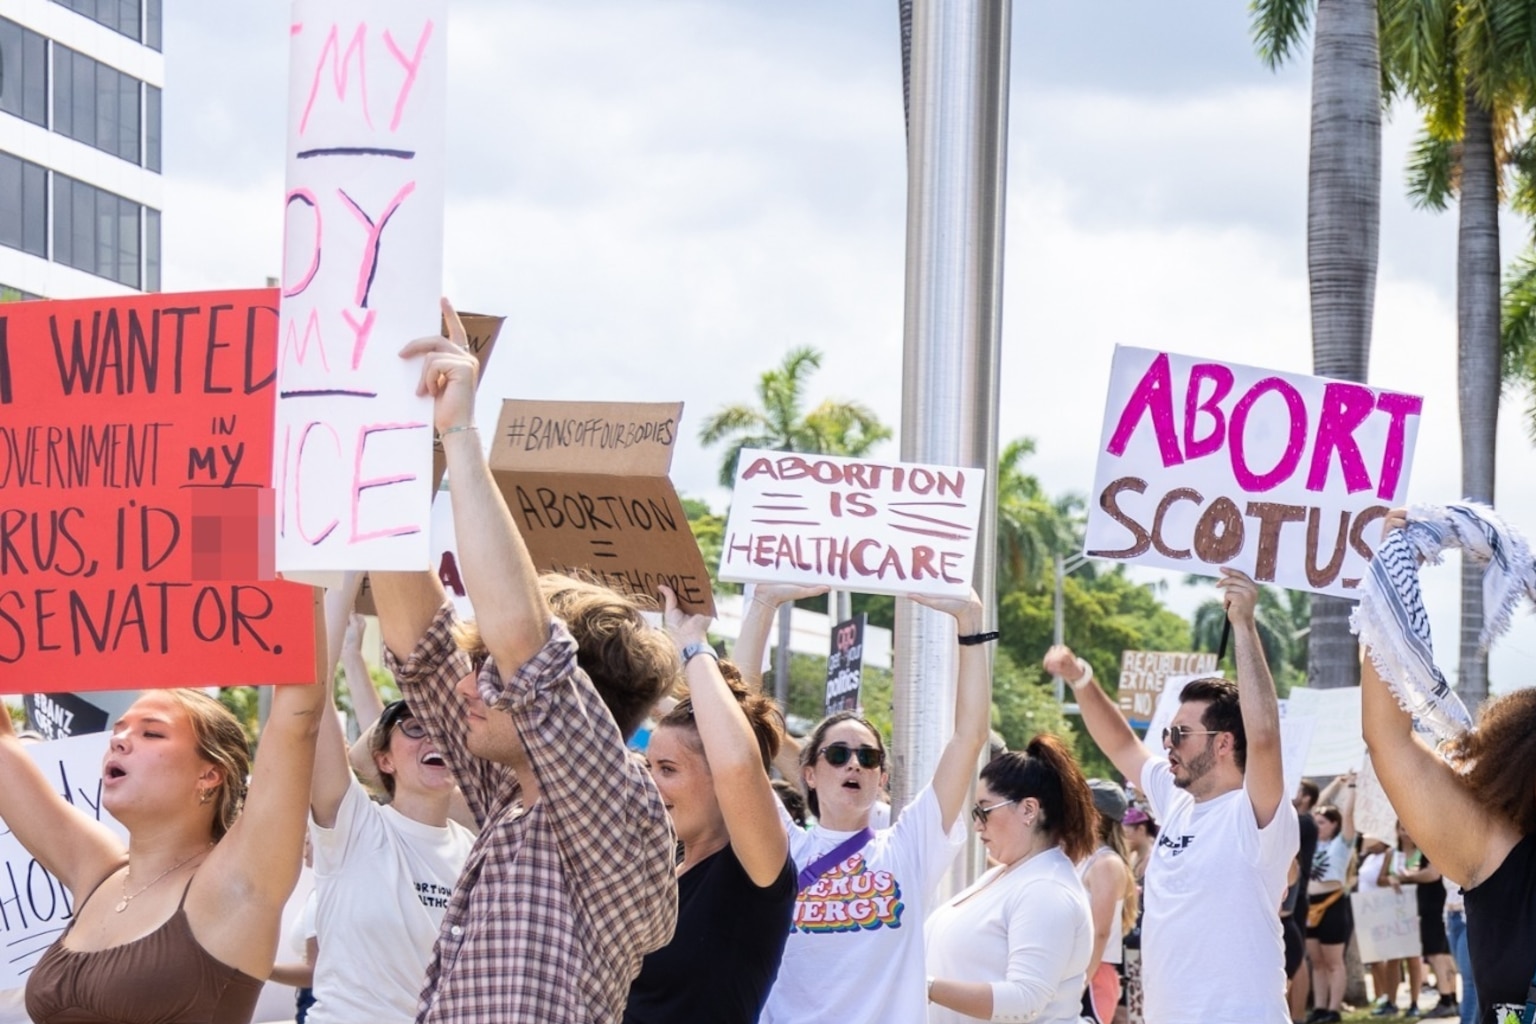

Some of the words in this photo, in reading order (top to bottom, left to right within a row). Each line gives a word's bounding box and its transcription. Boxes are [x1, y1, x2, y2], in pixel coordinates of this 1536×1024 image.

[300, 20, 434, 135] MY
[49, 305, 281, 396] WANTED
[280, 307, 377, 383] MY
[211, 414, 237, 435] IN
[1106, 352, 1424, 501] ABORT
[188, 442, 245, 488] MY
[741, 457, 965, 498] ABORTION
[117, 500, 181, 572] I'D
[515, 485, 678, 531] ABORTION
[830, 492, 877, 518] IS
[1087, 477, 1391, 589] SCOTUS
[727, 533, 966, 584] HEALTHCARE
[0, 581, 284, 664] SENATOR.
